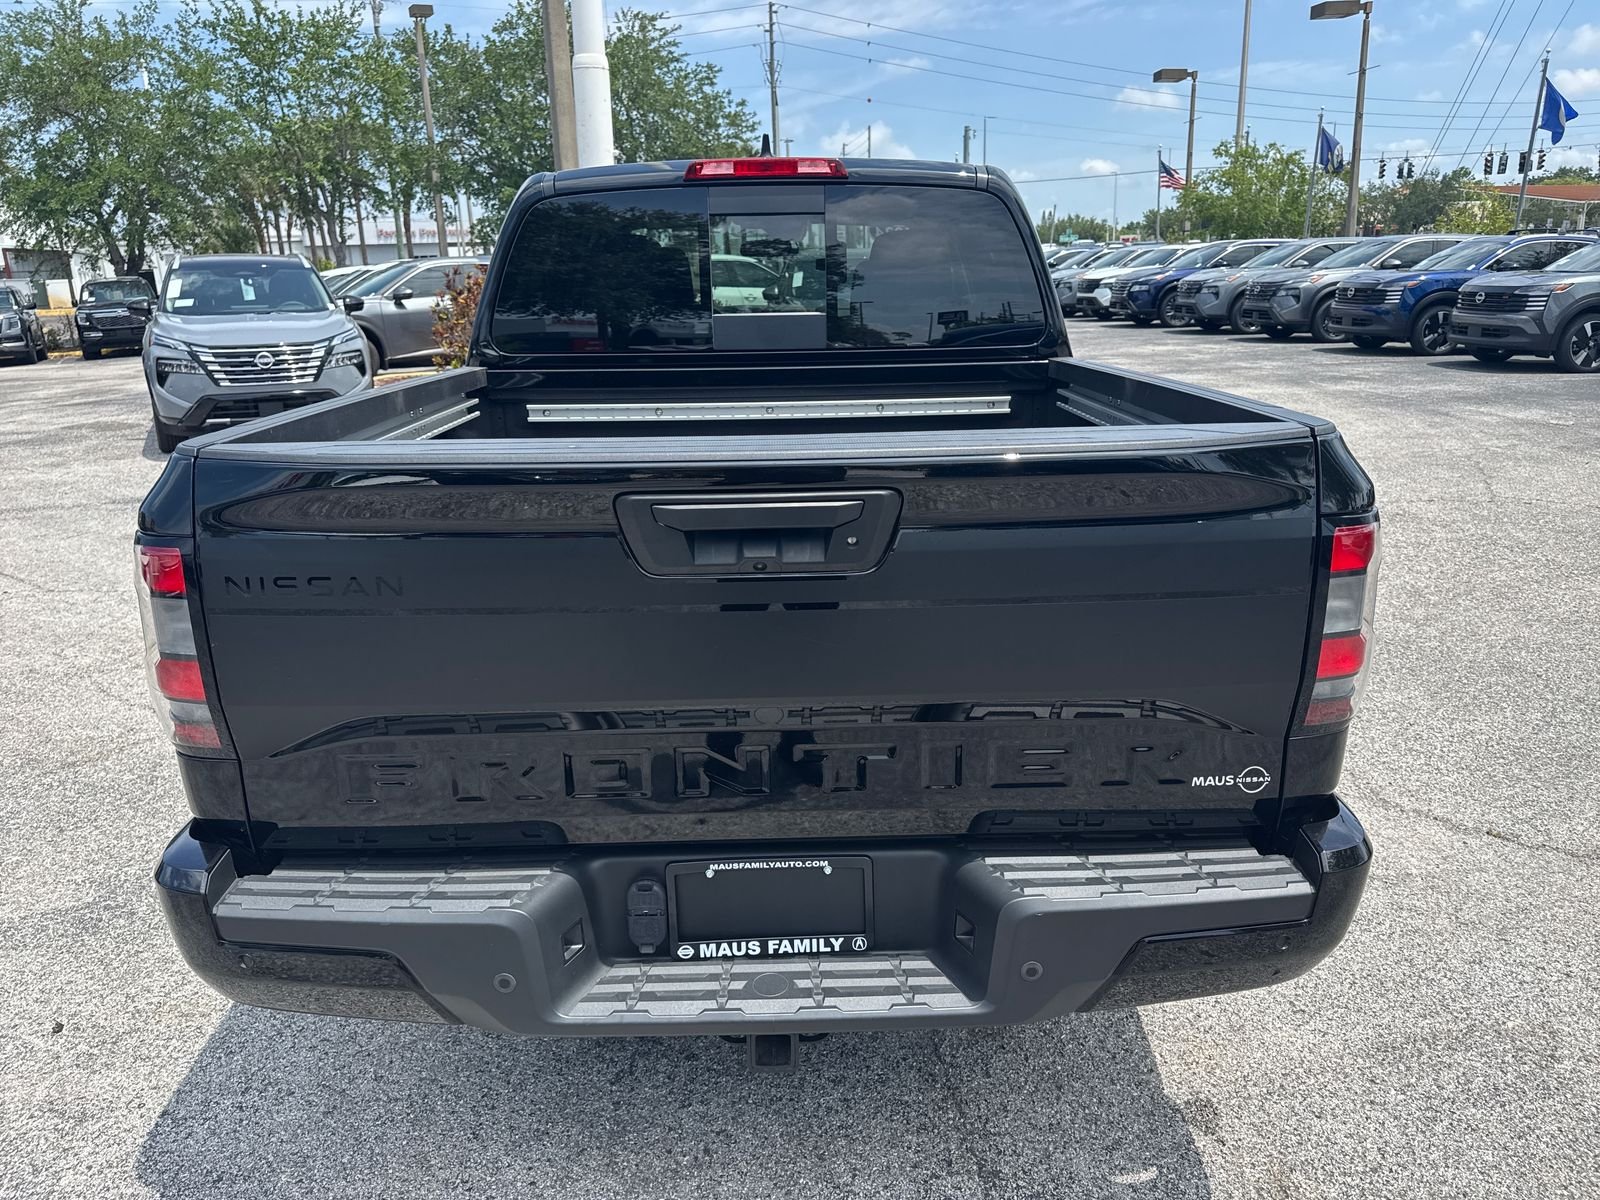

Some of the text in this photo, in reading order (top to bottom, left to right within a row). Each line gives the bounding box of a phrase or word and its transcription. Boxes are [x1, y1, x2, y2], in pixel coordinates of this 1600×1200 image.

[224, 576, 404, 597] NISSAN
[337, 743, 1186, 805] FRONTIER
[1191, 775, 1272, 787] MAUS NISSAN
[709, 860, 830, 871] MAUSFAMILYAUTO.COM
[699, 937, 845, 959] MAUS FAMILY
